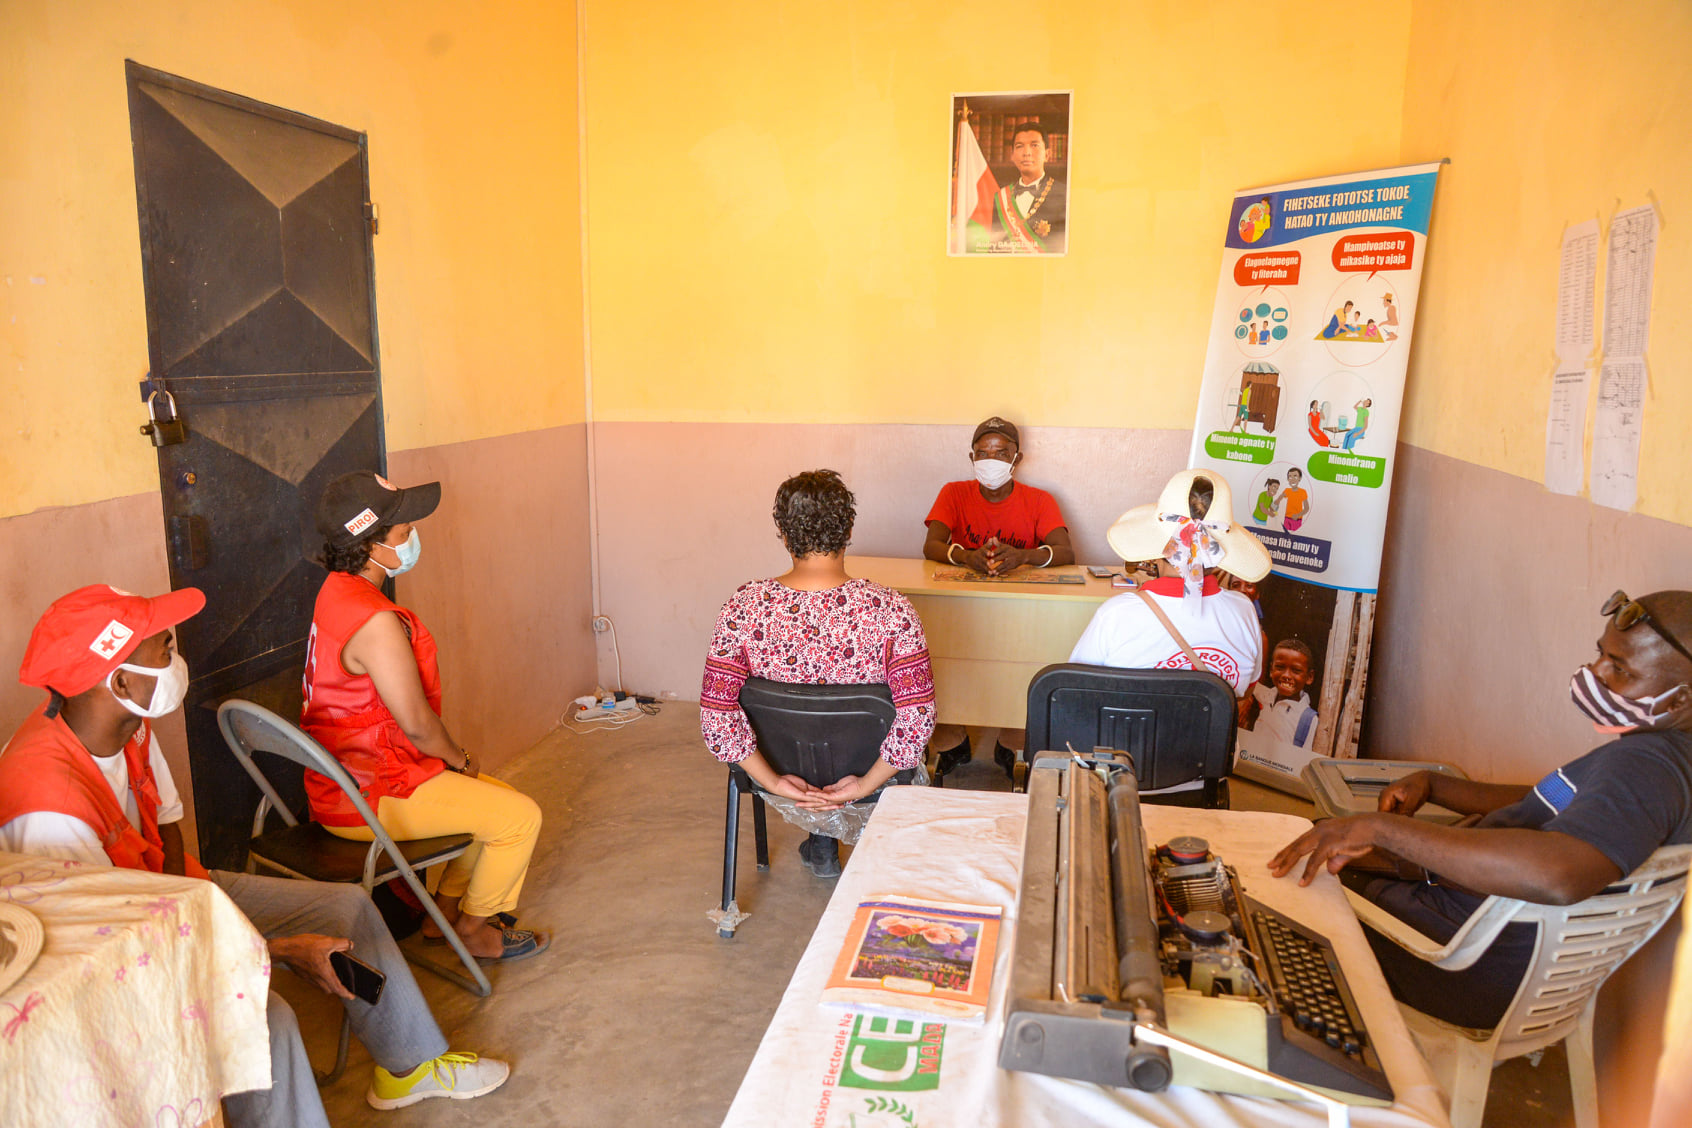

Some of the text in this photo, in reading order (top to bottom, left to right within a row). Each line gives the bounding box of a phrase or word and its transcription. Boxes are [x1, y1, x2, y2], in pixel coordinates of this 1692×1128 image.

[1283, 185, 1410, 212] FIHETSEKE FOTOTSE TOKOE
[1284, 205, 1404, 230] HATAO TY ANKOHONAGNE
[1328, 454, 1376, 469] Minondrano
[348, 511, 375, 533] PIROI
[1292, 541, 1310, 553] amy
[1310, 544, 1320, 554] ty
[1199, 652, 1236, 681] ROUGE
[811, 1089, 833, 1128] ission
[822, 1029, 849, 1087] Electorale
